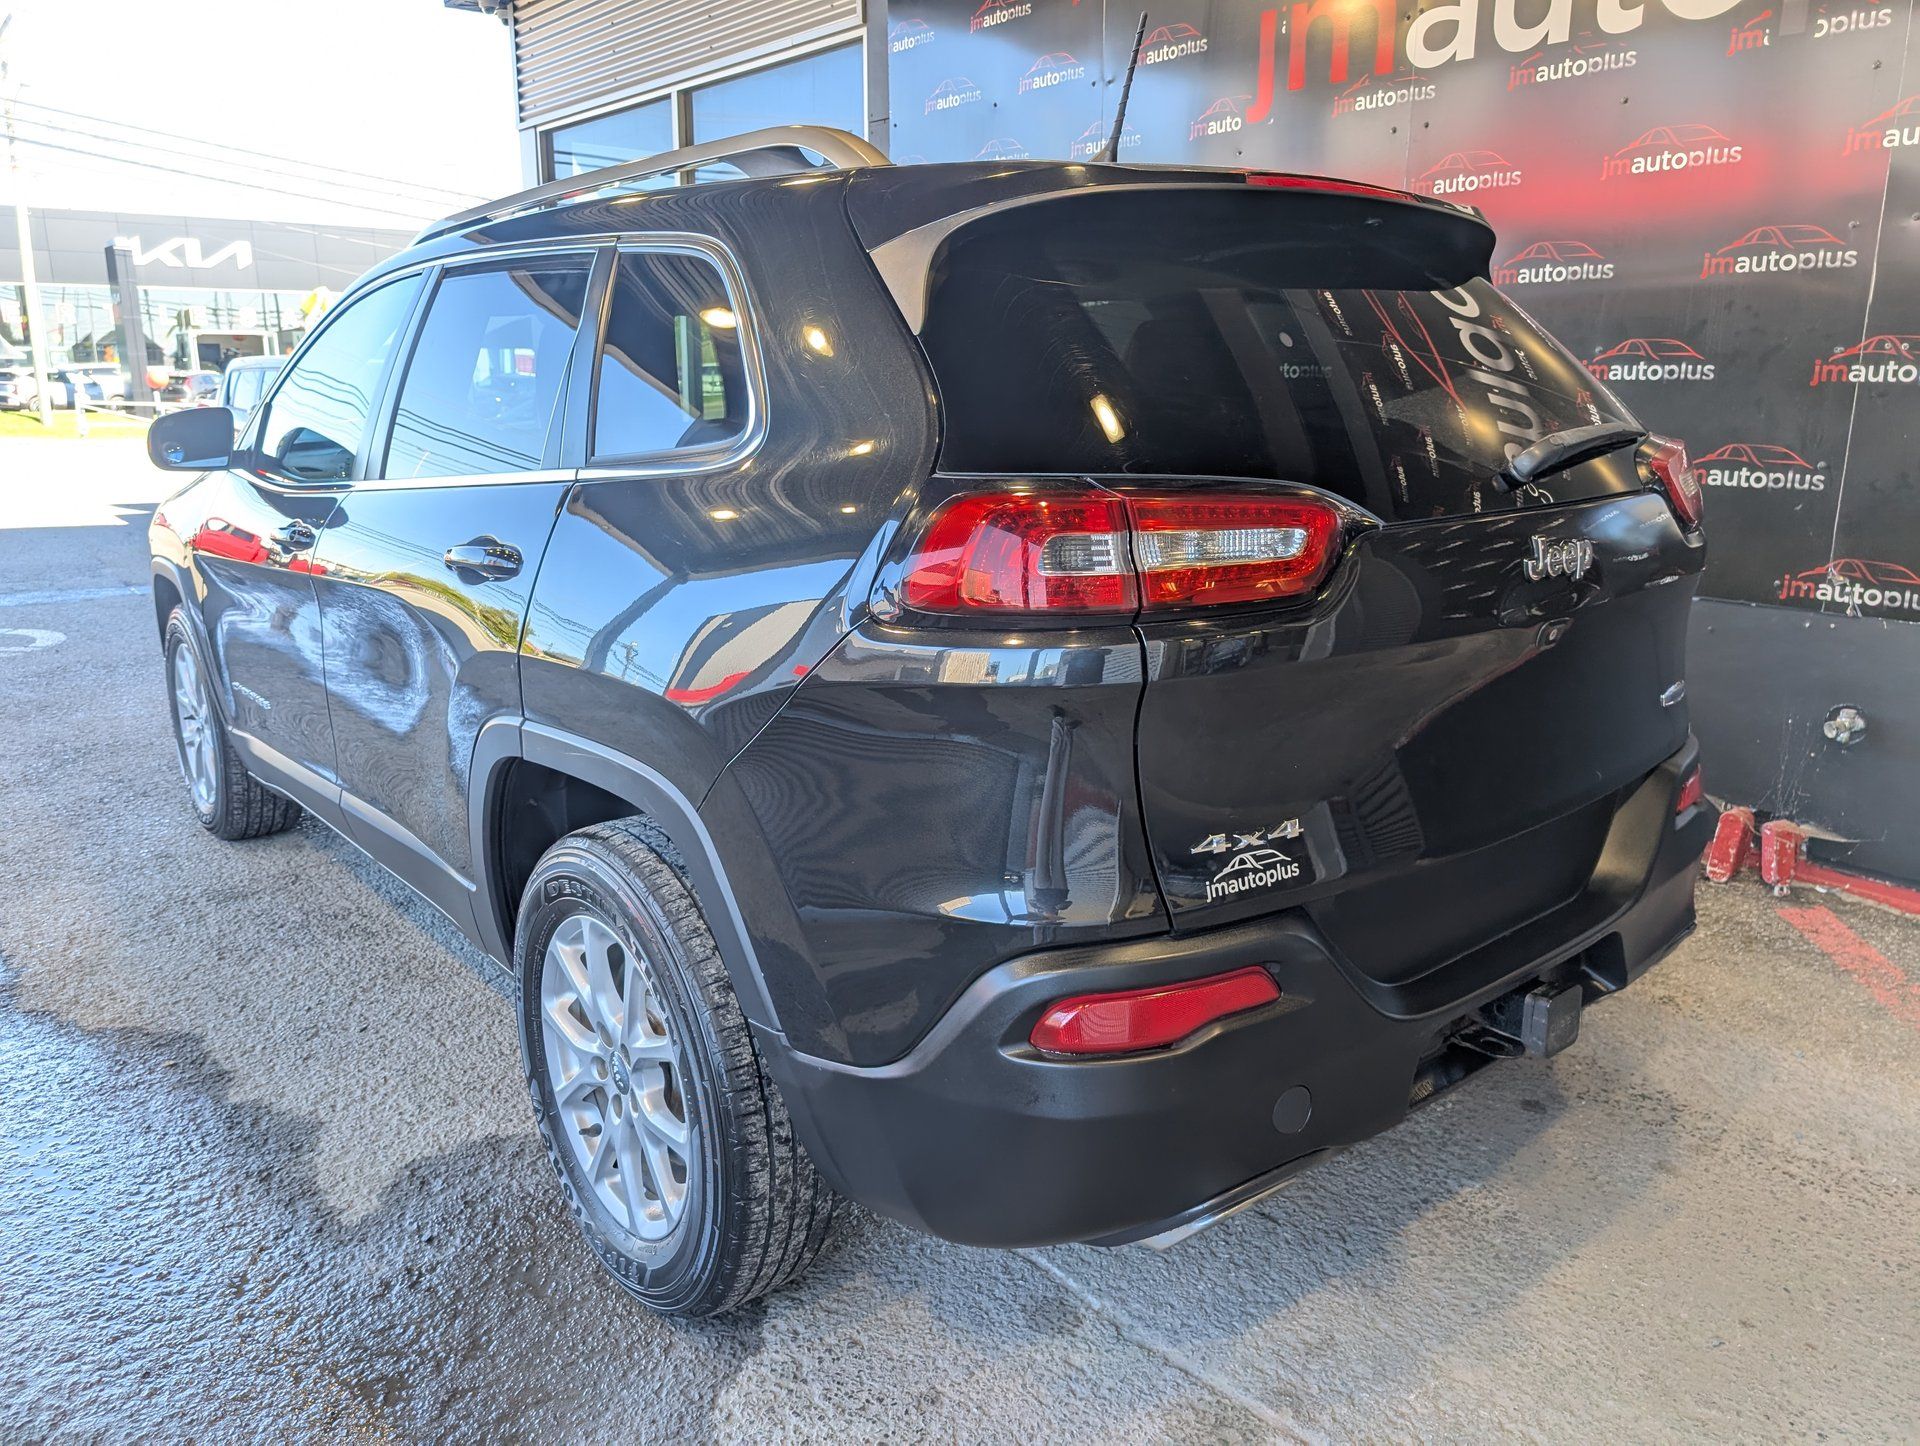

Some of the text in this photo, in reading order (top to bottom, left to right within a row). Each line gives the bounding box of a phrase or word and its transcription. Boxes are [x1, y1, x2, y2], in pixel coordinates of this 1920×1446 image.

[970, 3, 1032, 33] jmautoplus
[888, 30, 934, 53] autoplus
[1019, 66, 1085, 95] jmautoplus
[1507, 49, 1637, 91] jmautoplus
[924, 89, 982, 115] jmautoplus
[1331, 83, 1436, 118] jmautoplus
[1601, 146, 1742, 180] jmautoplus
[1701, 249, 1857, 279] jmautoplus
[1810, 360, 1920, 387] jmauto
[1523, 535, 1594, 581] Jeep
[1205, 862, 1300, 903] jmautoplus
